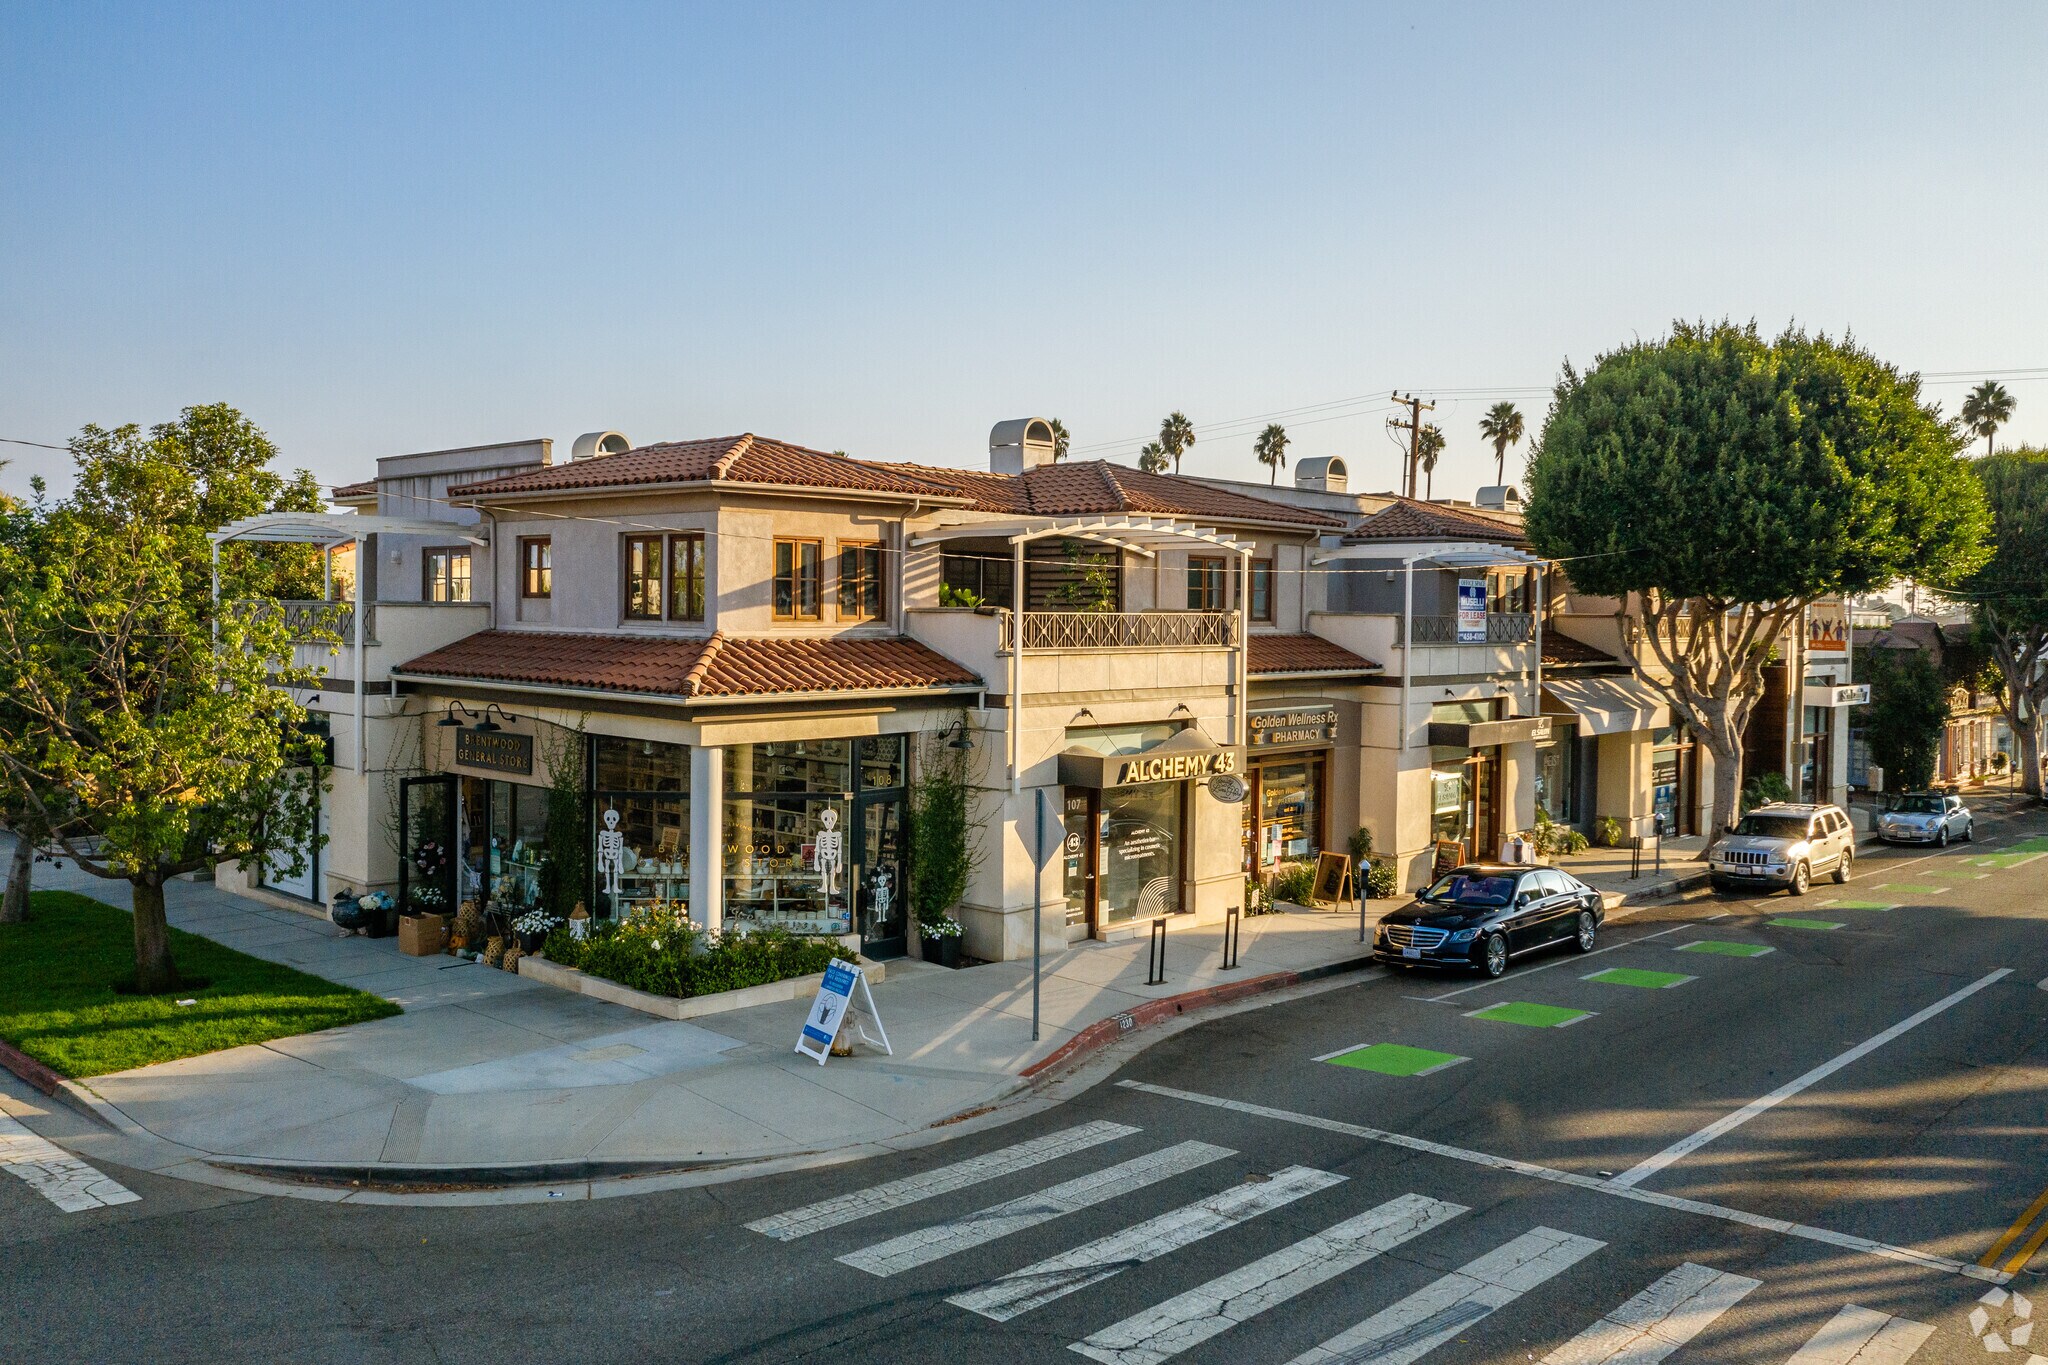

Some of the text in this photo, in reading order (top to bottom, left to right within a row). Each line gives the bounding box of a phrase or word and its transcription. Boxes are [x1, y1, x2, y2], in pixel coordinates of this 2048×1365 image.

[1254, 710, 1339, 729] Golden Wellness Rx
[465, 734, 521, 750] BRENTWOOD
[1275, 729, 1320, 743] PHARMACY
[458, 749, 529, 768] GENERAL STORE
[1125, 751, 1235, 783] ALCHEMY 43
[873, 774, 892, 786] 108
[1067, 799, 1081, 811] 107
[1069, 837, 1079, 848] 43
[744, 858, 806, 868] STORE
